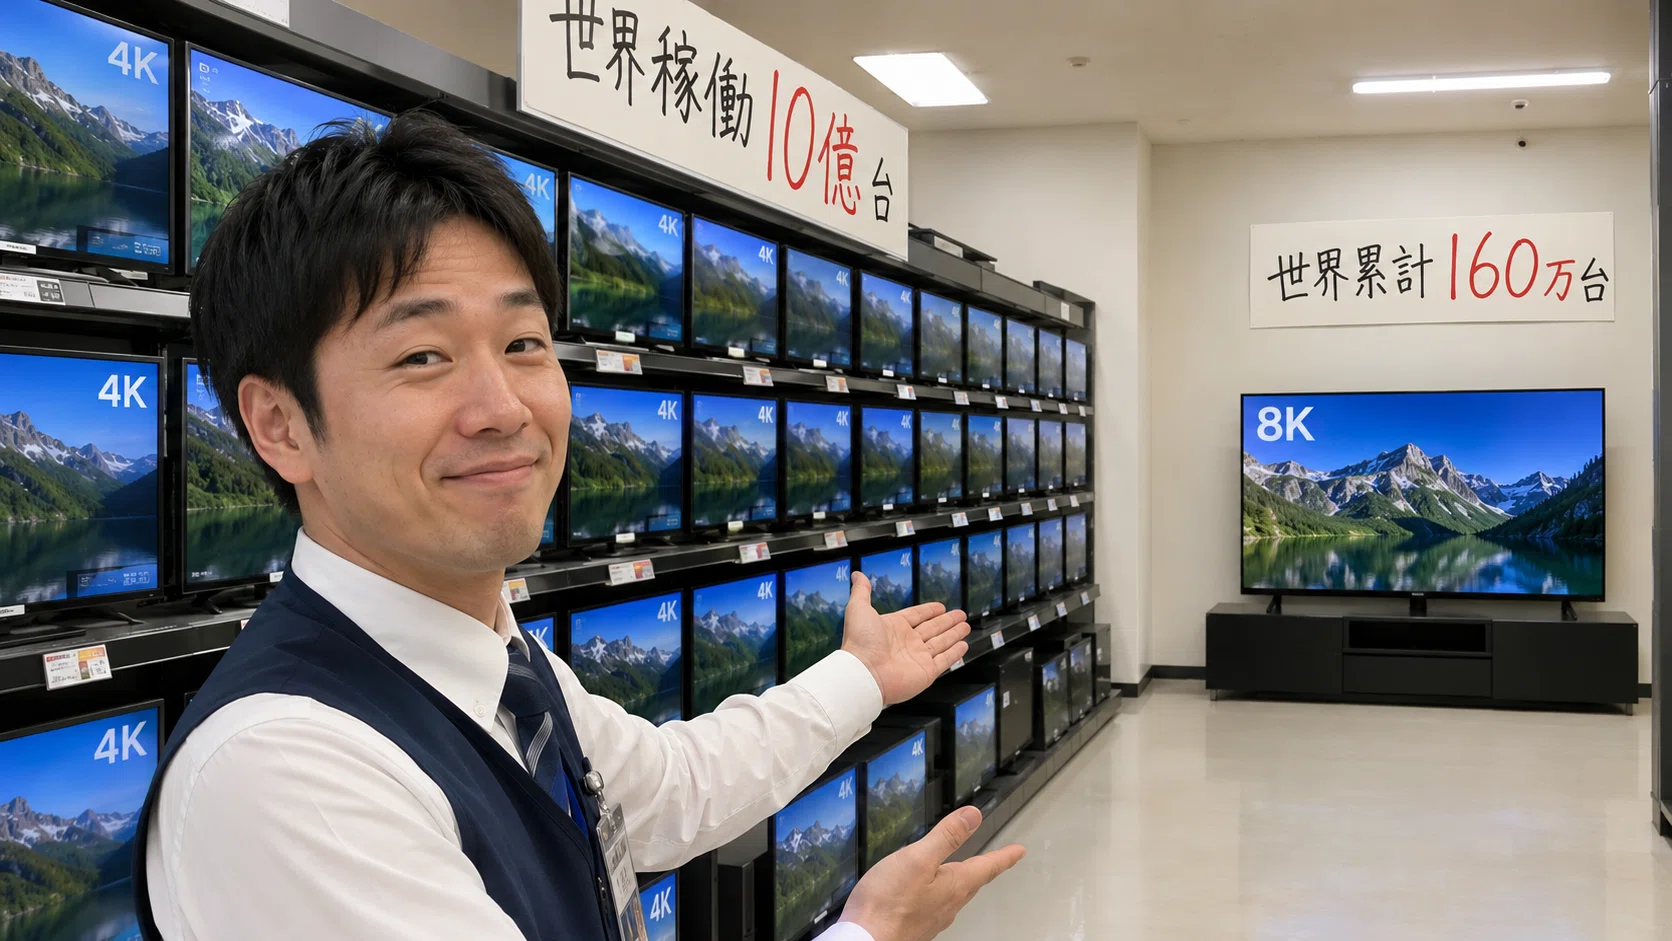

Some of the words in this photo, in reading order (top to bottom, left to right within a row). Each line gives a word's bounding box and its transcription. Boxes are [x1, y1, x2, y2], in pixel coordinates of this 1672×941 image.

[107, 41, 159, 85] 4K
[549, 0, 894, 223] 世界稼働10億台
[524, 173, 550, 200] 4K
[658, 214, 679, 236] 4K
[758, 244, 774, 264] 4K
[836, 269, 849, 287] 4K
[1267, 231, 1610, 303] 世界累計160万台
[900, 290, 911, 304] 4K
[98, 374, 147, 409] 4K
[657, 399, 678, 421] 4K
[758, 405, 774, 424] 4K
[835, 410, 849, 427] 4K
[900, 414, 911, 429] 4K
[1257, 406, 1315, 442] 8K
[900, 550, 911, 567] 4K
[835, 565, 849, 583] 4K
[757, 580, 773, 600] 4K
[657, 600, 678, 622] 4K
[529, 626, 549, 648] K
[93, 720, 147, 764] 4K
[911, 738, 924, 757] 4K
[838, 775, 853, 800] 4K
[649, 885, 672, 922] 4K
